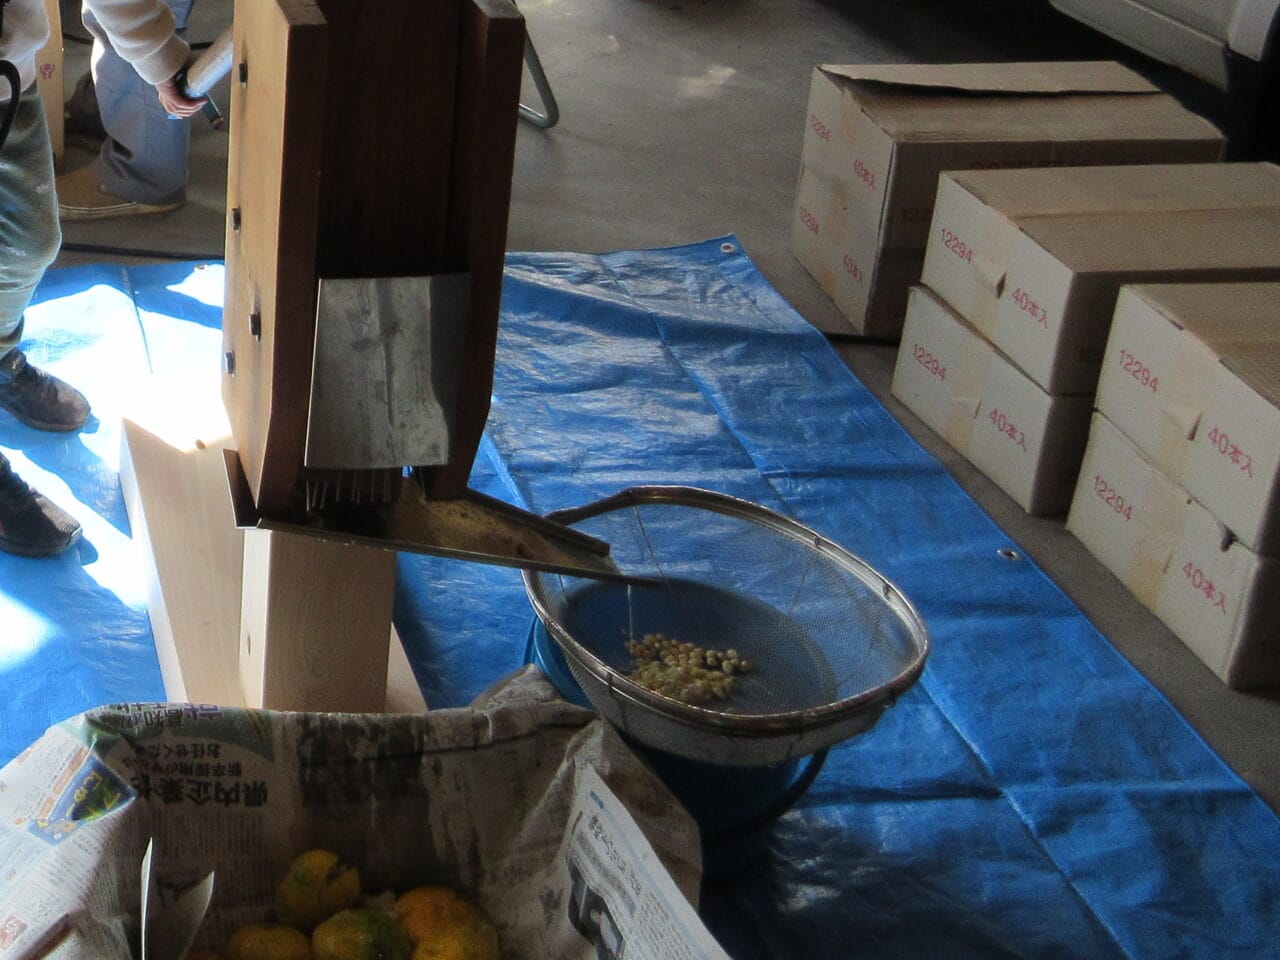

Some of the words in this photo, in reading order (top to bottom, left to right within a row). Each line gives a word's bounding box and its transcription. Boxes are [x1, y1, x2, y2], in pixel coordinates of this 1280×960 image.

[809, 114, 832, 143] 12294
[798, 205, 821, 236] 12294
[940, 227, 974, 266] 12294
[1011, 286, 1050, 330] 40本入
[912, 343, 948, 382] 12294
[1119, 349, 1160, 393] 12294
[987, 407, 1028, 453] 40本入
[1207, 426, 1255, 480] 40本入
[1093, 474, 1134, 522] 12294
[1181, 560, 1229, 615] 40本入
